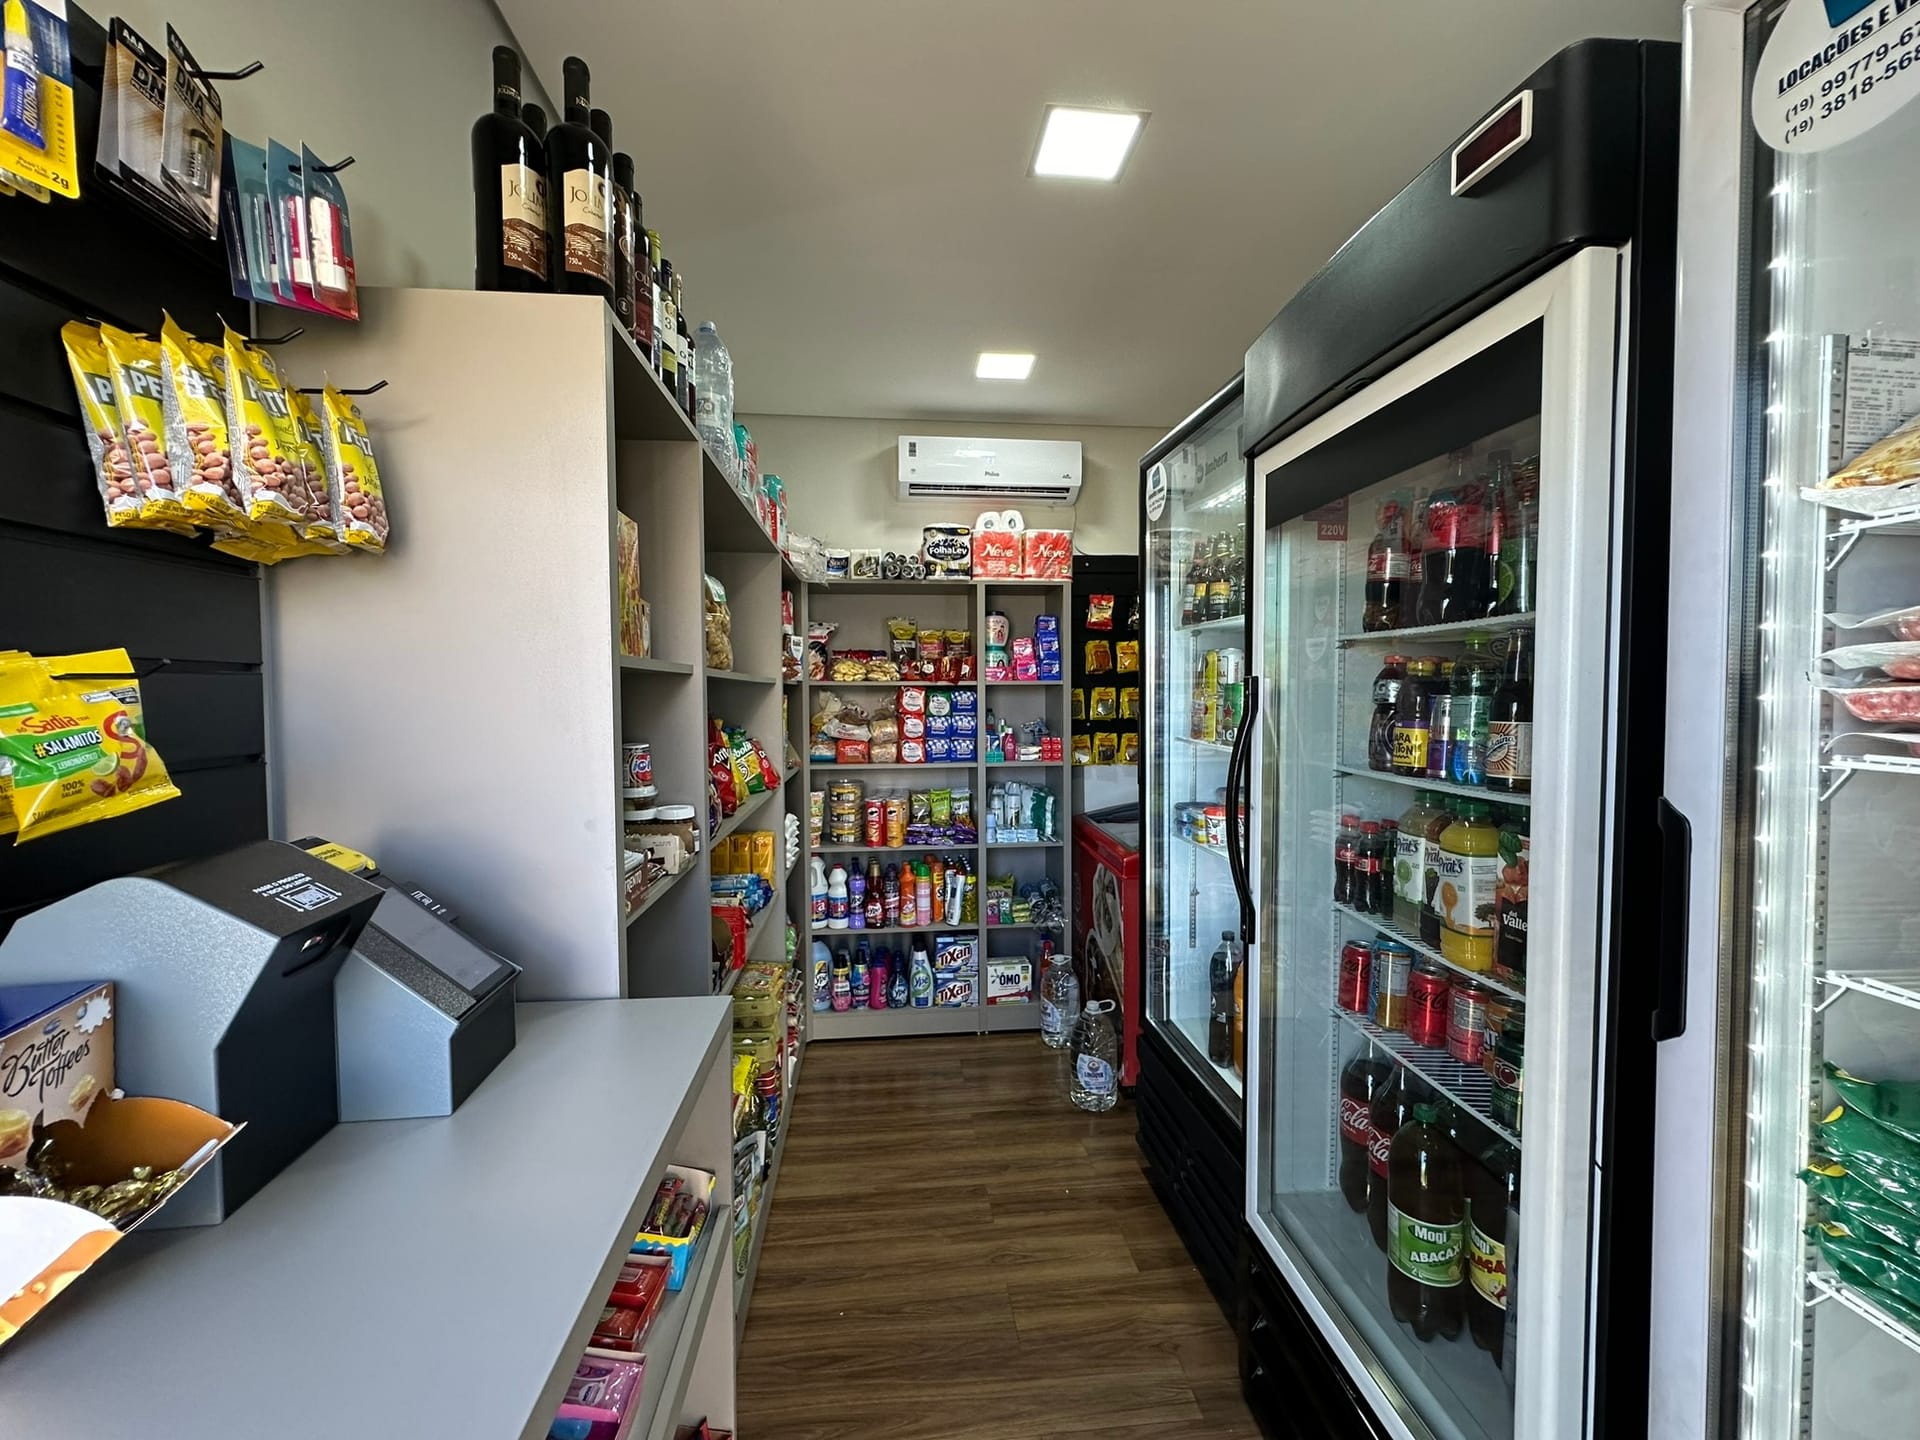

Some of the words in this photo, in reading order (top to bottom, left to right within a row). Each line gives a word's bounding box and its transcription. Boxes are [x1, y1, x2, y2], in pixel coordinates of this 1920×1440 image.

[1778, 17, 1874, 95] LOCAÇÕES
[1878, 5, 1890, 27] E
[1785, 94, 1815, 123] (19)
[1784, 116, 1815, 145] (19)
[51, 171, 70, 190] 2g
[1321, 523, 1344, 536] 220V
[981, 543, 1014, 557] Neve
[1034, 544, 1066, 558] Neve
[22, 715, 79, 734] Sadia
[34, 729, 103, 759] #SALAMITOS
[62, 779, 85, 791] 100%
[1502, 914, 1529, 932] Valle
[1, 1028, 70, 1099] Butter
[28, 1039, 91, 1105] Toffees
[1414, 1225, 1447, 1245] Mogi
